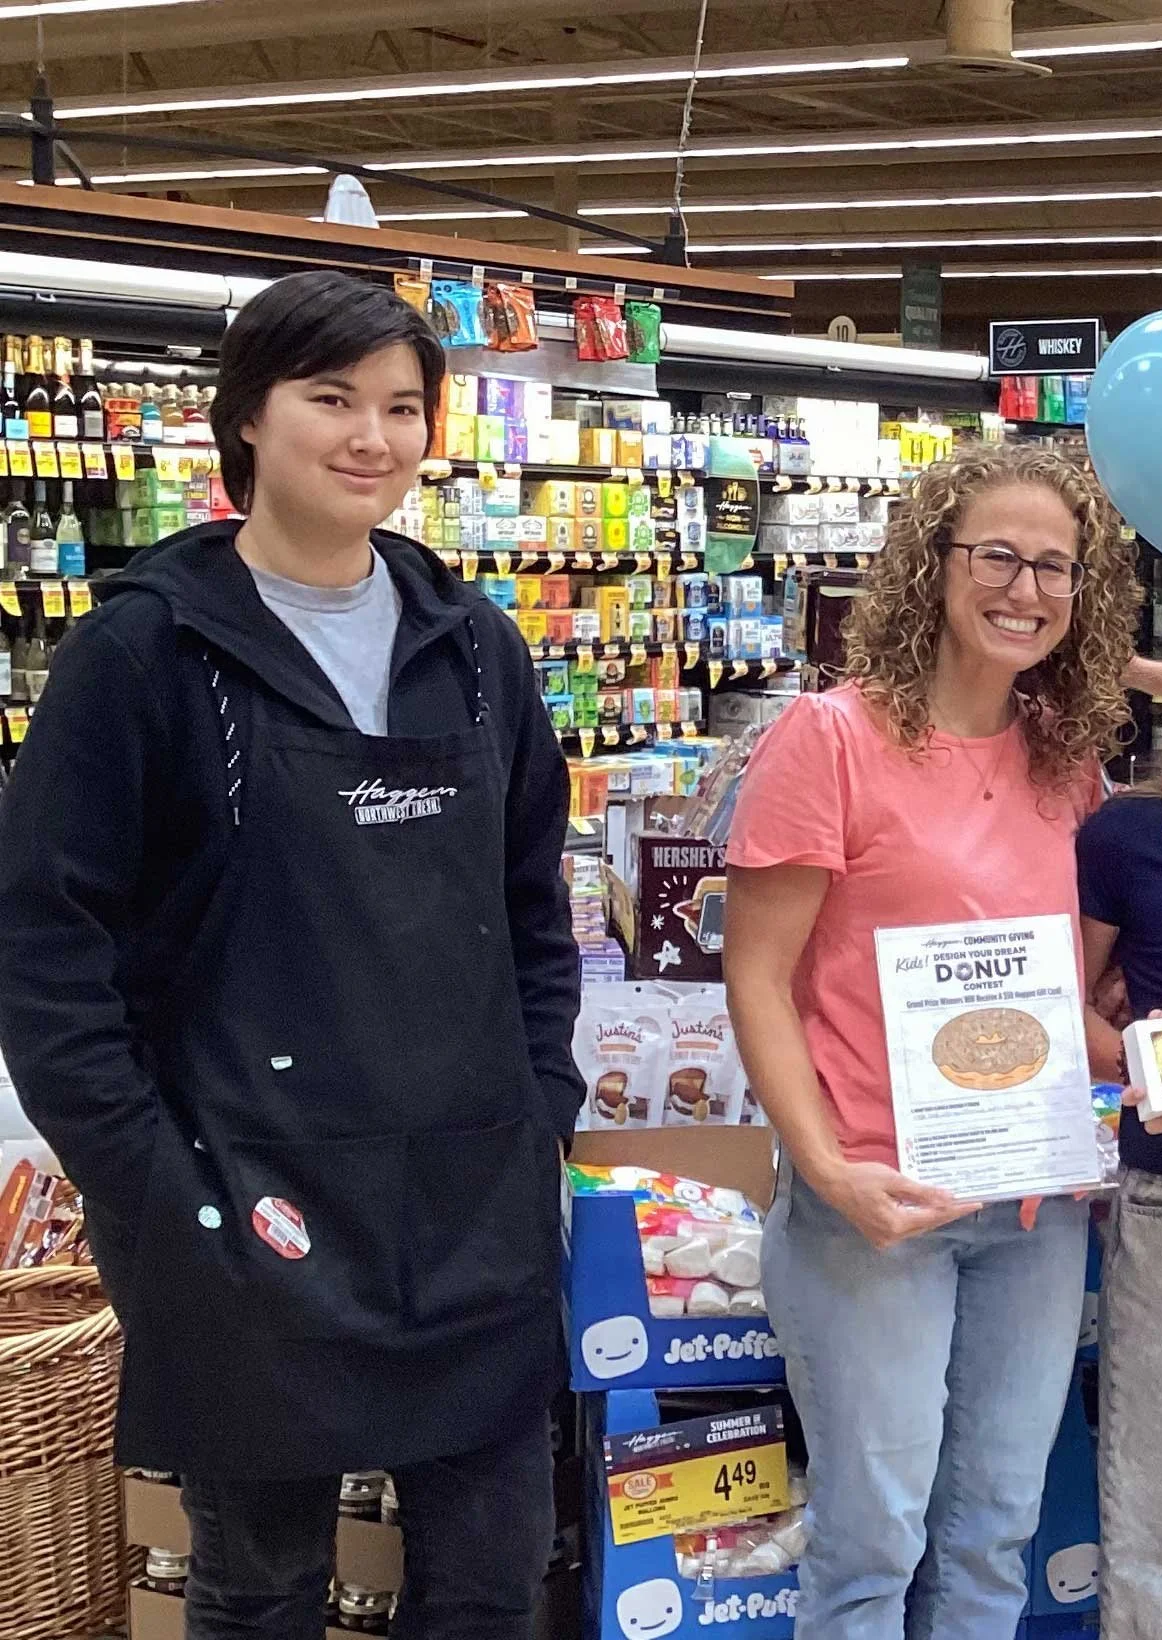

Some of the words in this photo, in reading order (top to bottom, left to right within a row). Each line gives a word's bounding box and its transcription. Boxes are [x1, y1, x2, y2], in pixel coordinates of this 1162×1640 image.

[836, 324, 849, 342] 10
[1038, 337, 1083, 355] WHISKEY
[338, 778, 458, 808] Haggen
[358, 804, 410, 822] NORTHWEST
[653, 846, 727, 868] HERSHEY'S
[963, 932, 1007, 946] COMMUNITY
[1008, 930, 1035, 942] GIVING
[895, 954, 930, 973] Kids!
[933, 951, 967, 962] DESIGN
[968, 948, 993, 959] YOUR
[994, 946, 1027, 957] DREAM
[934, 956, 1027, 983] DONUT
[963, 980, 1004, 991] CONTEST
[597, 1023, 643, 1043] Justin's
[671, 1020, 725, 1041] Justin's
[664, 1329, 781, 1365] Jet-Puffe
[710, 1415, 751, 1432] SUMMER
[622, 1429, 684, 1448] Haggen
[706, 1424, 767, 1443] CELEBRATION
[627, 1473, 652, 1489] SALE
[698, 1588, 800, 1626] Jet-Puff
